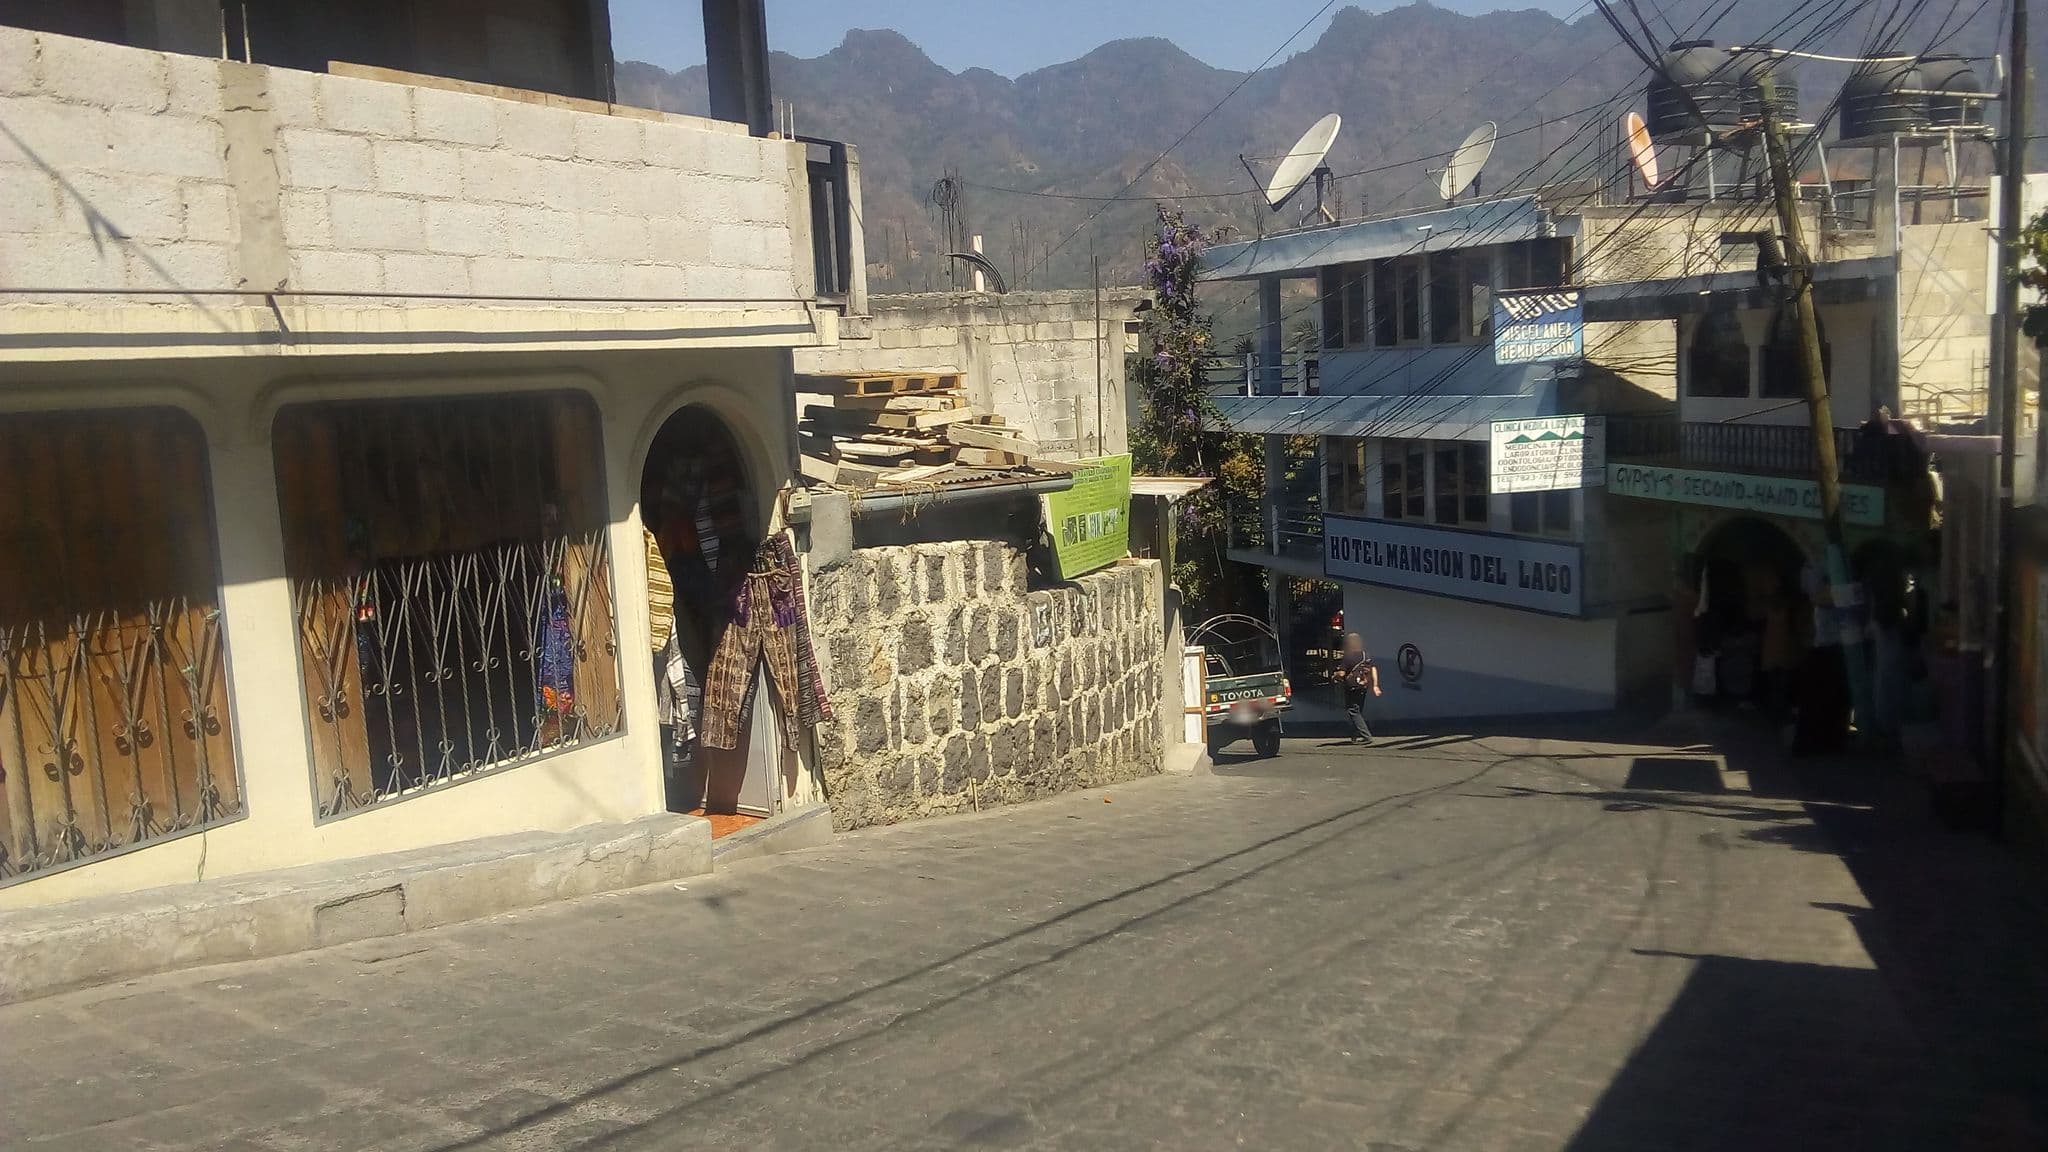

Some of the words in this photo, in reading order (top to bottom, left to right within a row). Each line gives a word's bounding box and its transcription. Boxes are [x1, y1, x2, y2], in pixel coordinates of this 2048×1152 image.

[1499, 292, 1578, 320] HOTEL
[1501, 341, 1575, 359] HENDERSON
[1504, 443, 1547, 451] MEDICINA
[1330, 535, 1383, 567] HOTEL
[1386, 543, 1464, 579] MANSION
[1470, 553, 1507, 586] DEL
[1518, 559, 1572, 595] LAGO
[1220, 688, 1264, 702] TOYOTA
